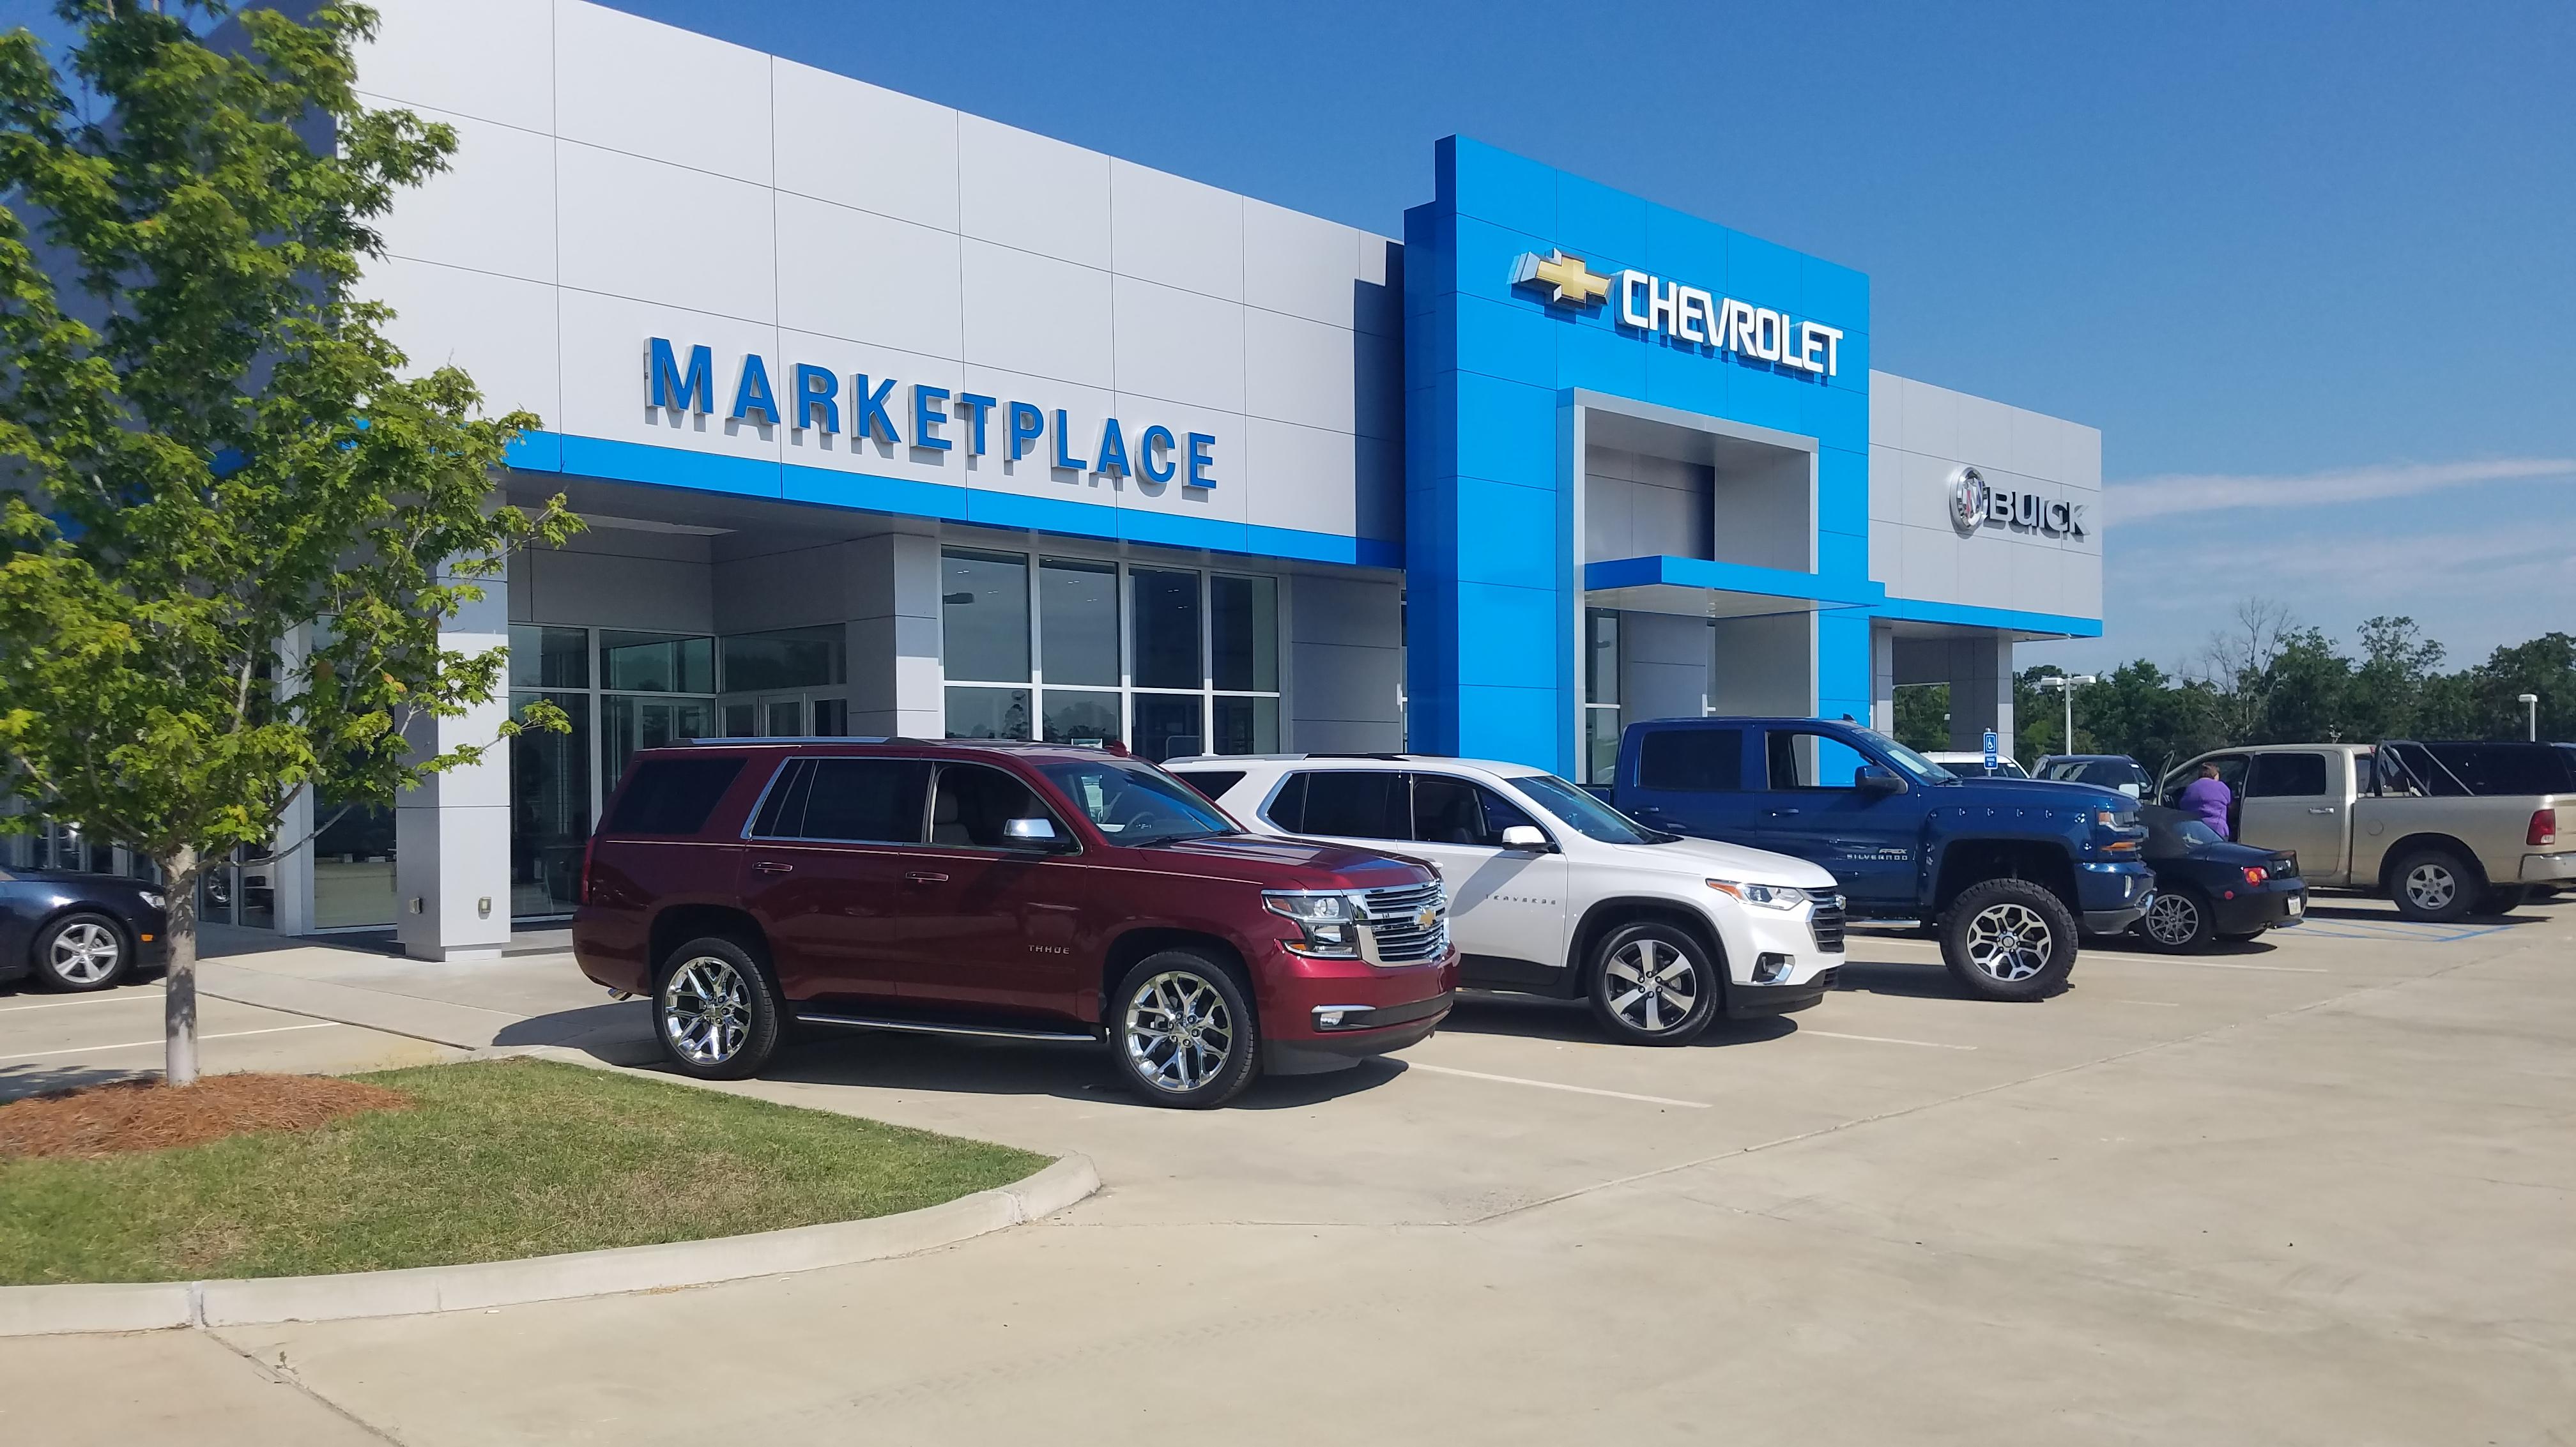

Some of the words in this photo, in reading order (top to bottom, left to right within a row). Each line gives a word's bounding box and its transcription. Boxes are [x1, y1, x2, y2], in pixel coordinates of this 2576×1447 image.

[1622, 268, 1844, 377] CHEVROLET
[647, 336, 1218, 491] MARKETPLACE
[1987, 486, 2090, 536] BUICK
[1028, 945, 1070, 954] TAHOE
